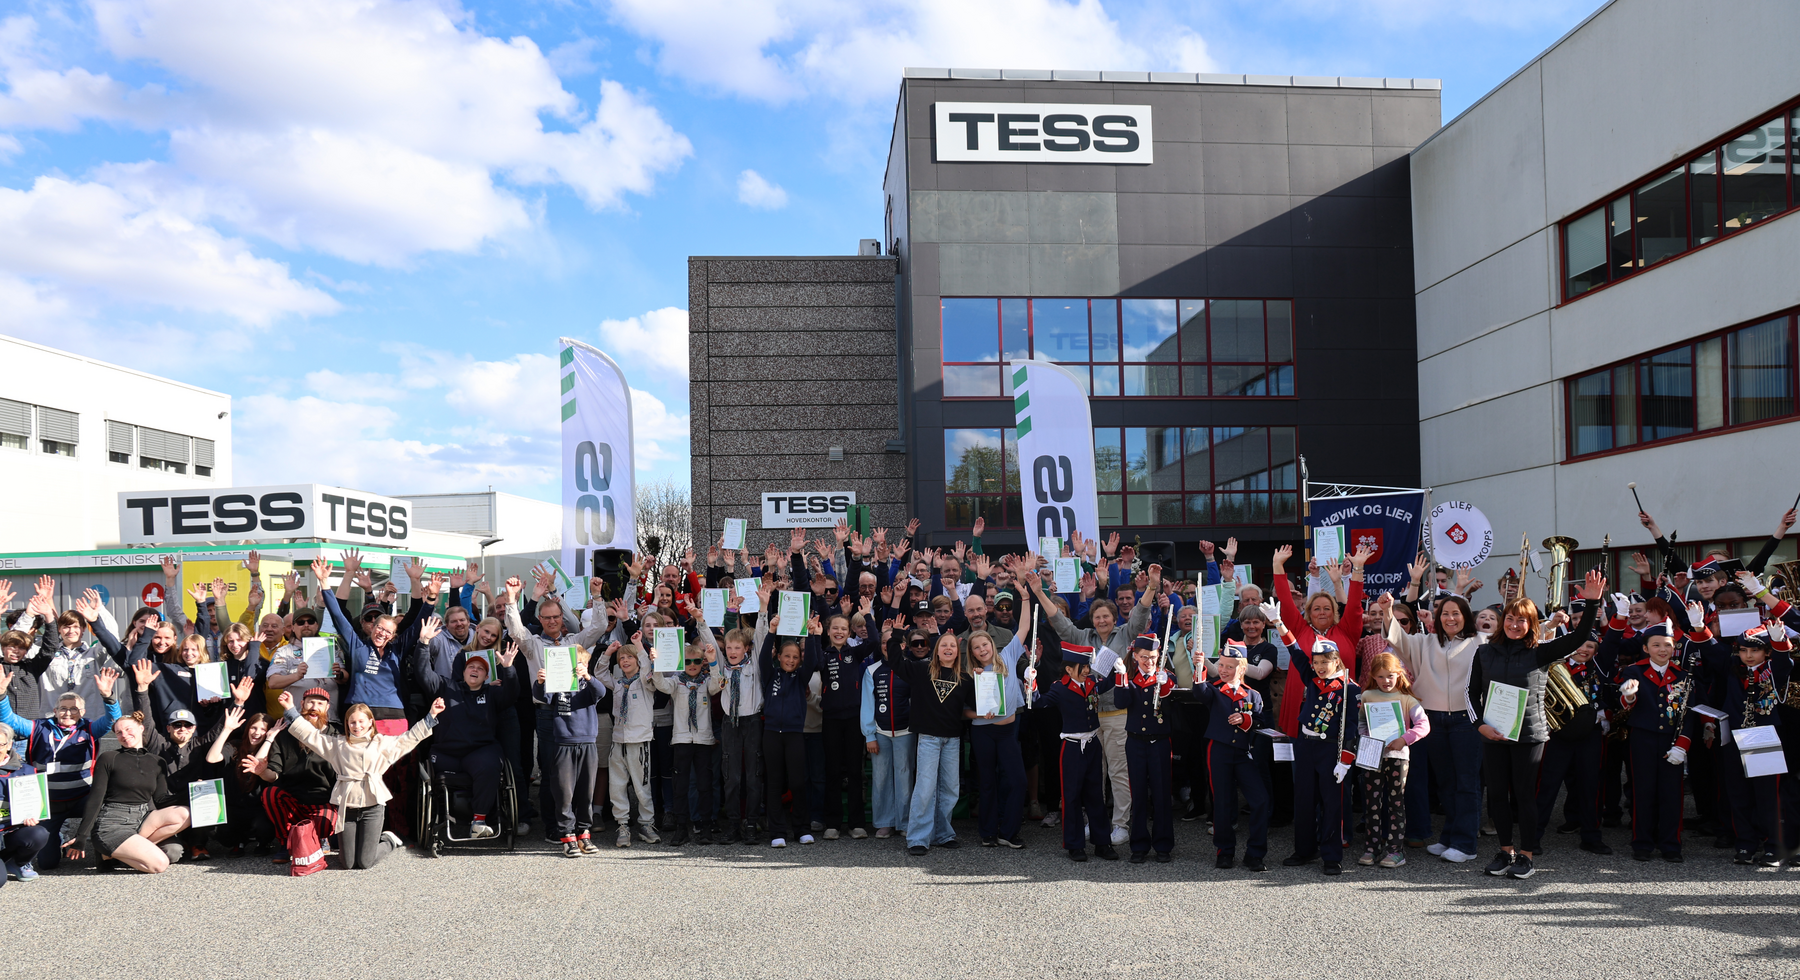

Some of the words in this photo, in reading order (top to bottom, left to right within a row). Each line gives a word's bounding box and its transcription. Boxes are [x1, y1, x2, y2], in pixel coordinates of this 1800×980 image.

[949, 113, 1139, 153] TESS
[127, 492, 305, 536] TESS
[322, 493, 408, 540] TESS
[767, 496, 850, 514] TESS
[1321, 506, 1360, 527] HØVIK
[1363, 504, 1382, 515] OG
[1385, 506, 1413, 524] LIER
[1431, 506, 1444, 518] OG
[1449, 501, 1473, 512] LIER
[91, 554, 155, 566] TEKNISK
[1451, 530, 1493, 569] SKOLEKORPS
